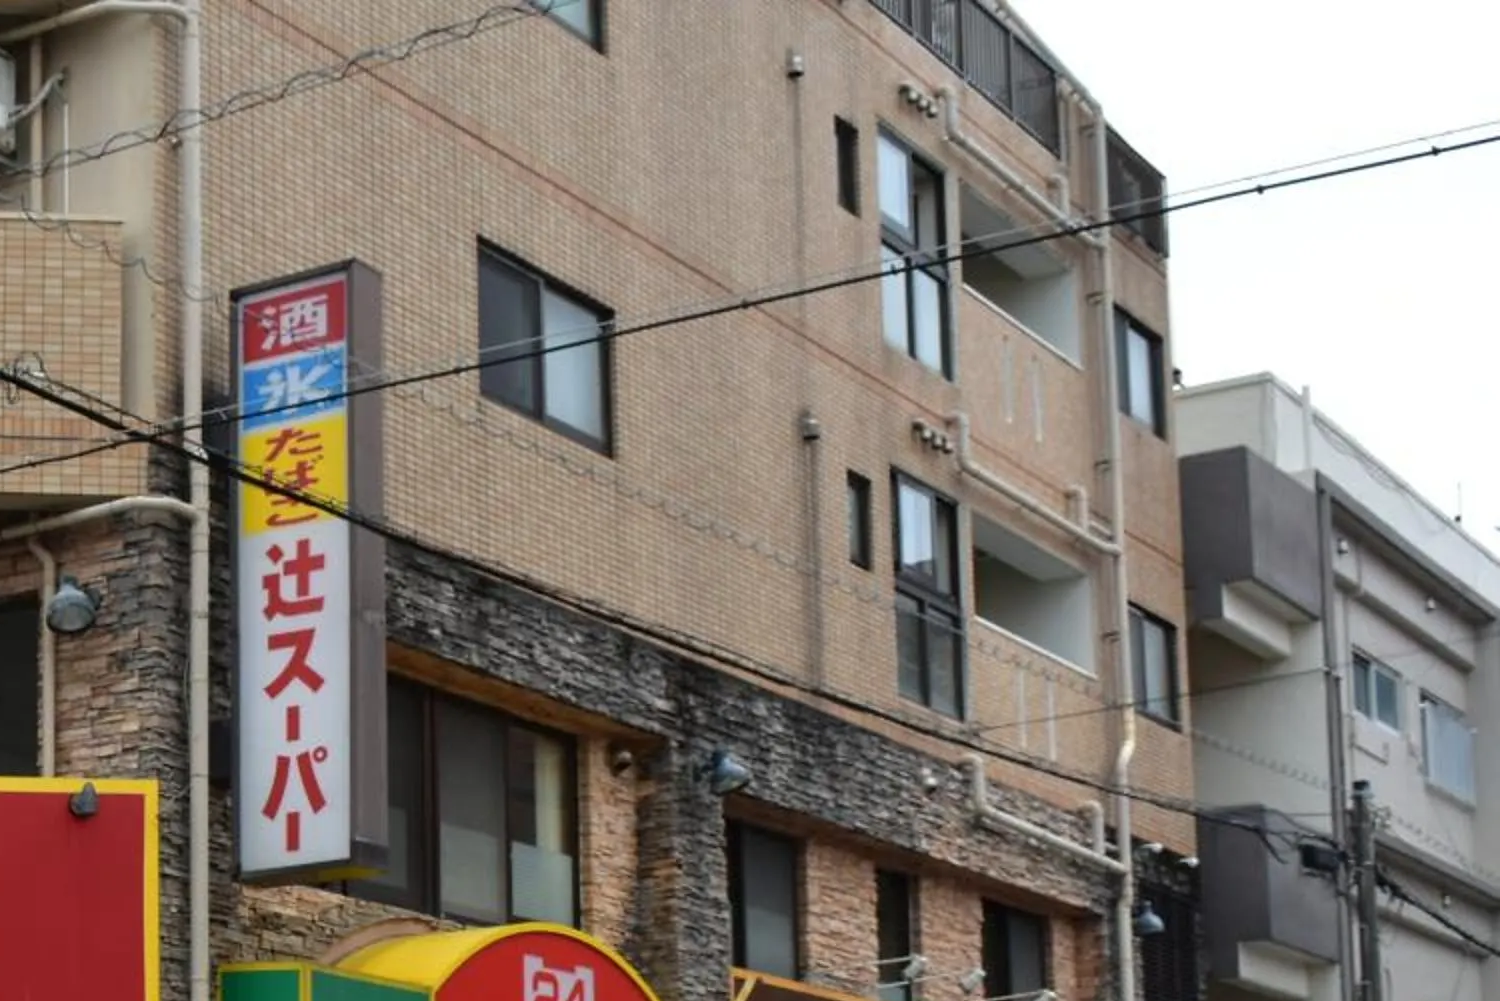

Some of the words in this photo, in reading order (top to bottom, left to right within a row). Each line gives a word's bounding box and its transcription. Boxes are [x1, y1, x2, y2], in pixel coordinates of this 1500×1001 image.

[258, 293, 329, 351] 酒
[257, 362, 332, 416] 氷
[264, 427, 324, 528] たばこ
[261, 539, 328, 852] 辻スーパー
